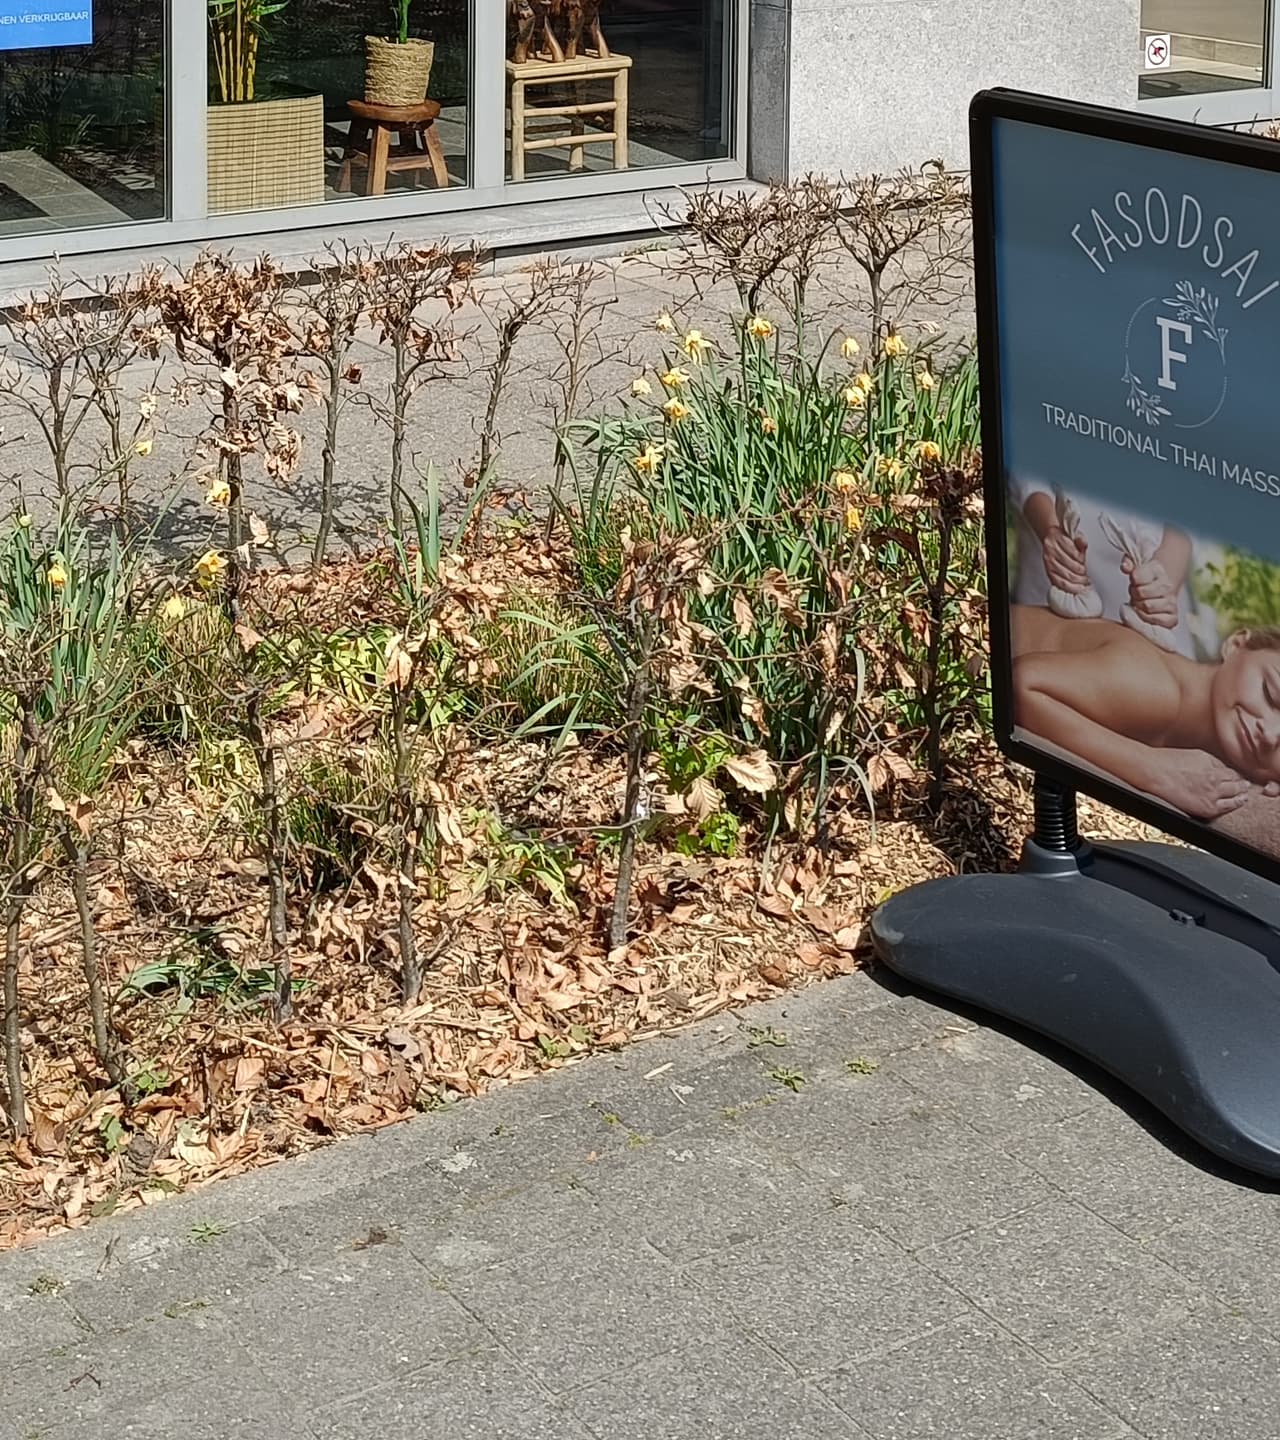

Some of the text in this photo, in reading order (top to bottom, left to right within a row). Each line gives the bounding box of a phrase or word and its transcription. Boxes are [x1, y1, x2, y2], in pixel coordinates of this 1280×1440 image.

[18, 10, 89, 25] VERKRIJGBAAR
[1071, 187, 1280, 309] FASODSAI
[1155, 316, 1193, 391] F
[1042, 402, 1168, 462] TRADITIONAL
[1170, 442, 1217, 477] THAI
